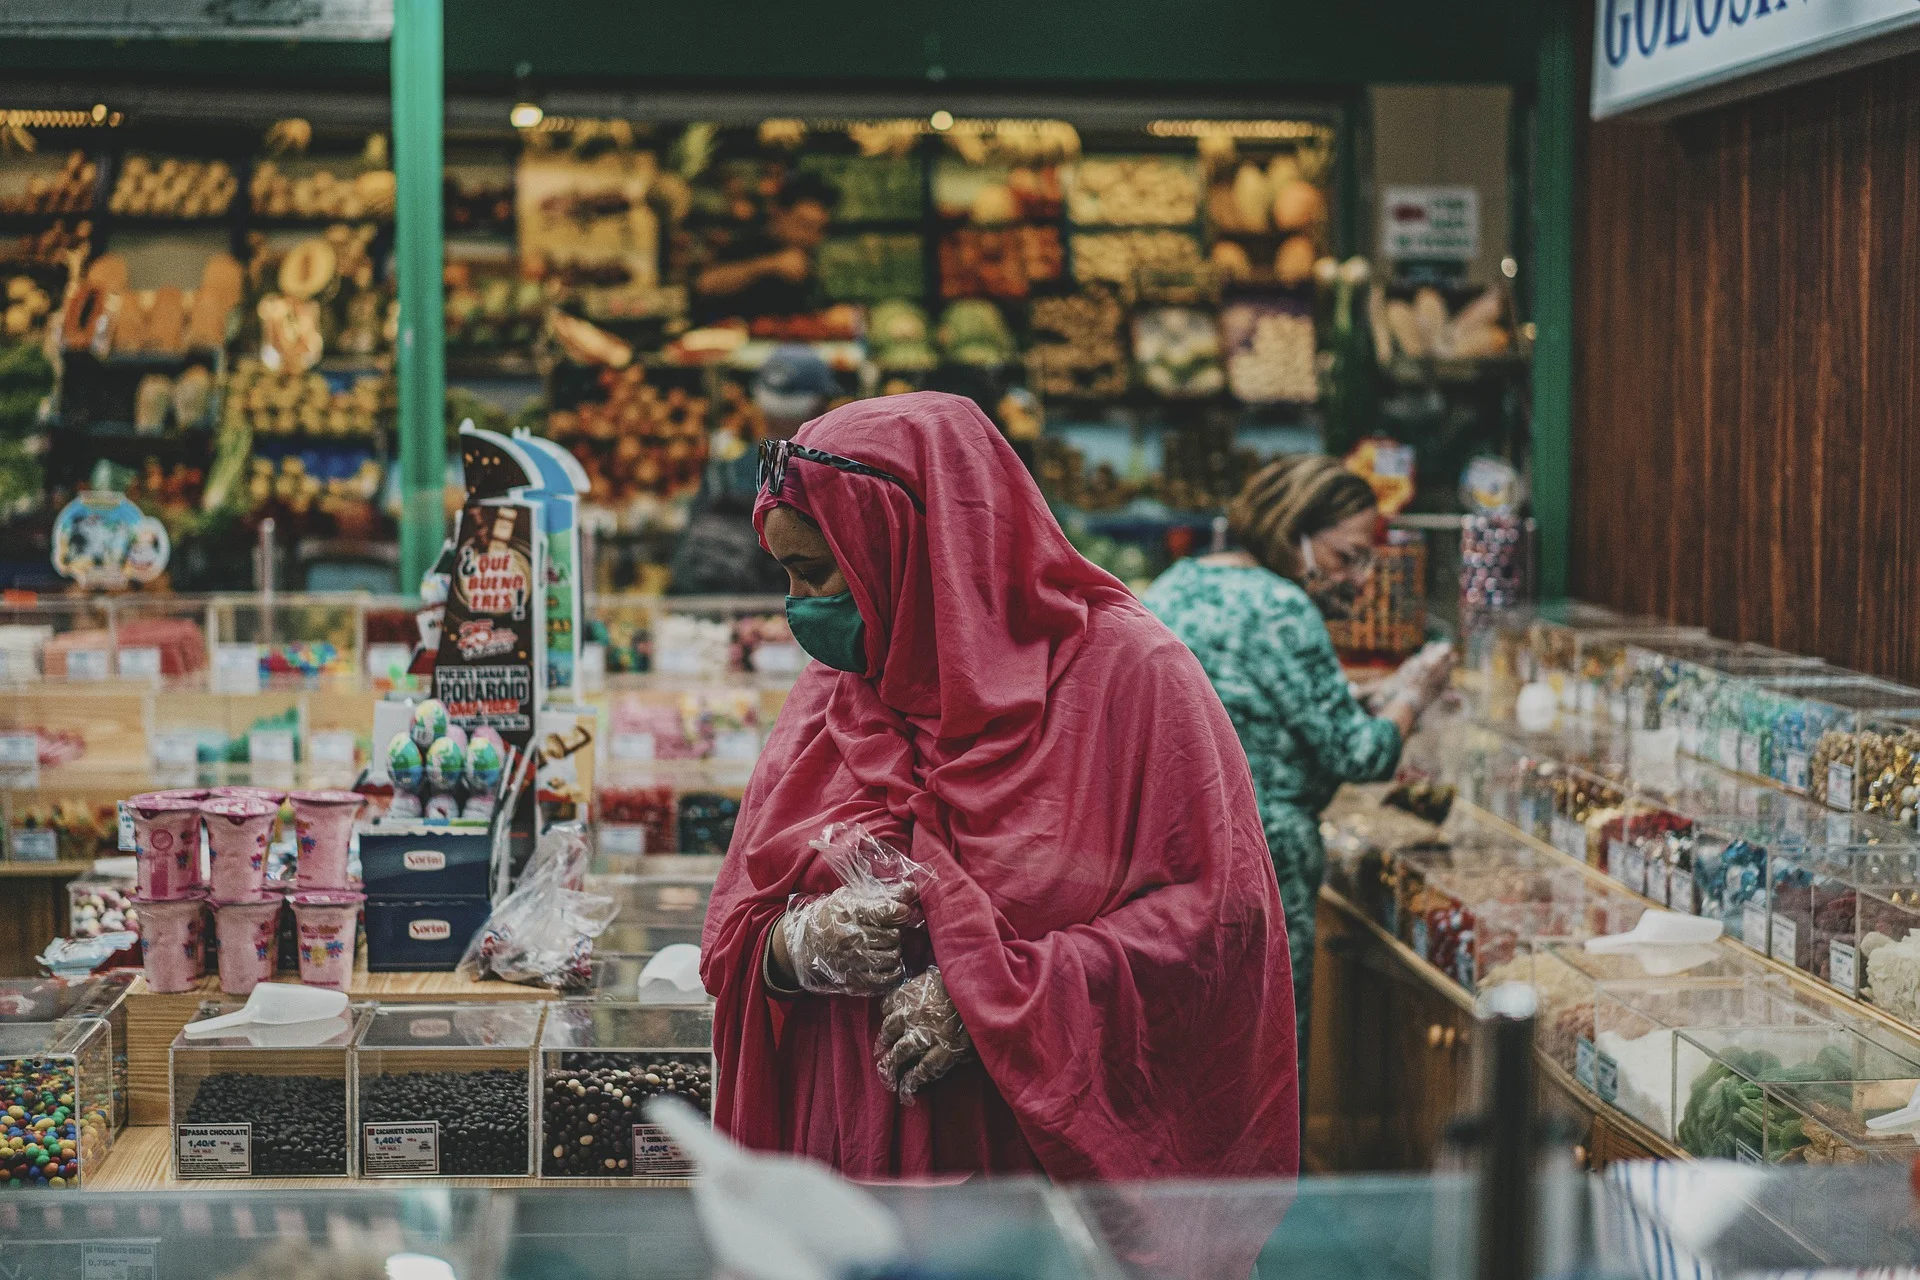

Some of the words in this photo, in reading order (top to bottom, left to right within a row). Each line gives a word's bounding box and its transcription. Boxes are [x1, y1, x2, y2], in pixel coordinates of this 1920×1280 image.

[1604, 0, 1787, 68] GOLO
[441, 682, 527, 702] POLAROID
[188, 1139, 217, 1148] 1,40/€
